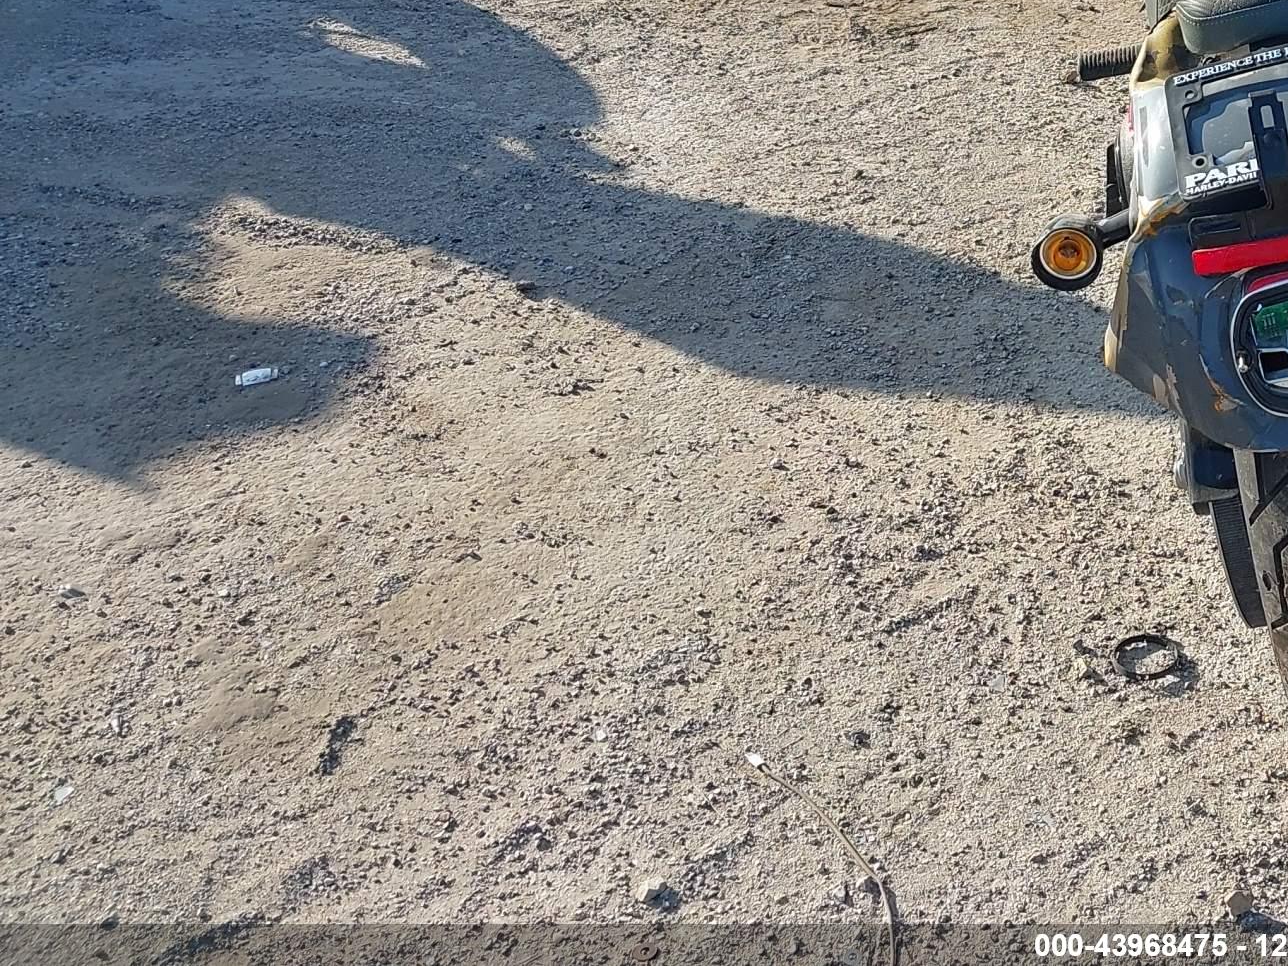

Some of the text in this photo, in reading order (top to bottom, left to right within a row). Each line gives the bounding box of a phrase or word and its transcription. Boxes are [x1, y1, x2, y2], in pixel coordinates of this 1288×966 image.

[1173, 56, 1254, 85] EXPERIENCE
[1253, 48, 1282, 64] THE
[1184, 159, 1260, 189] PARI
